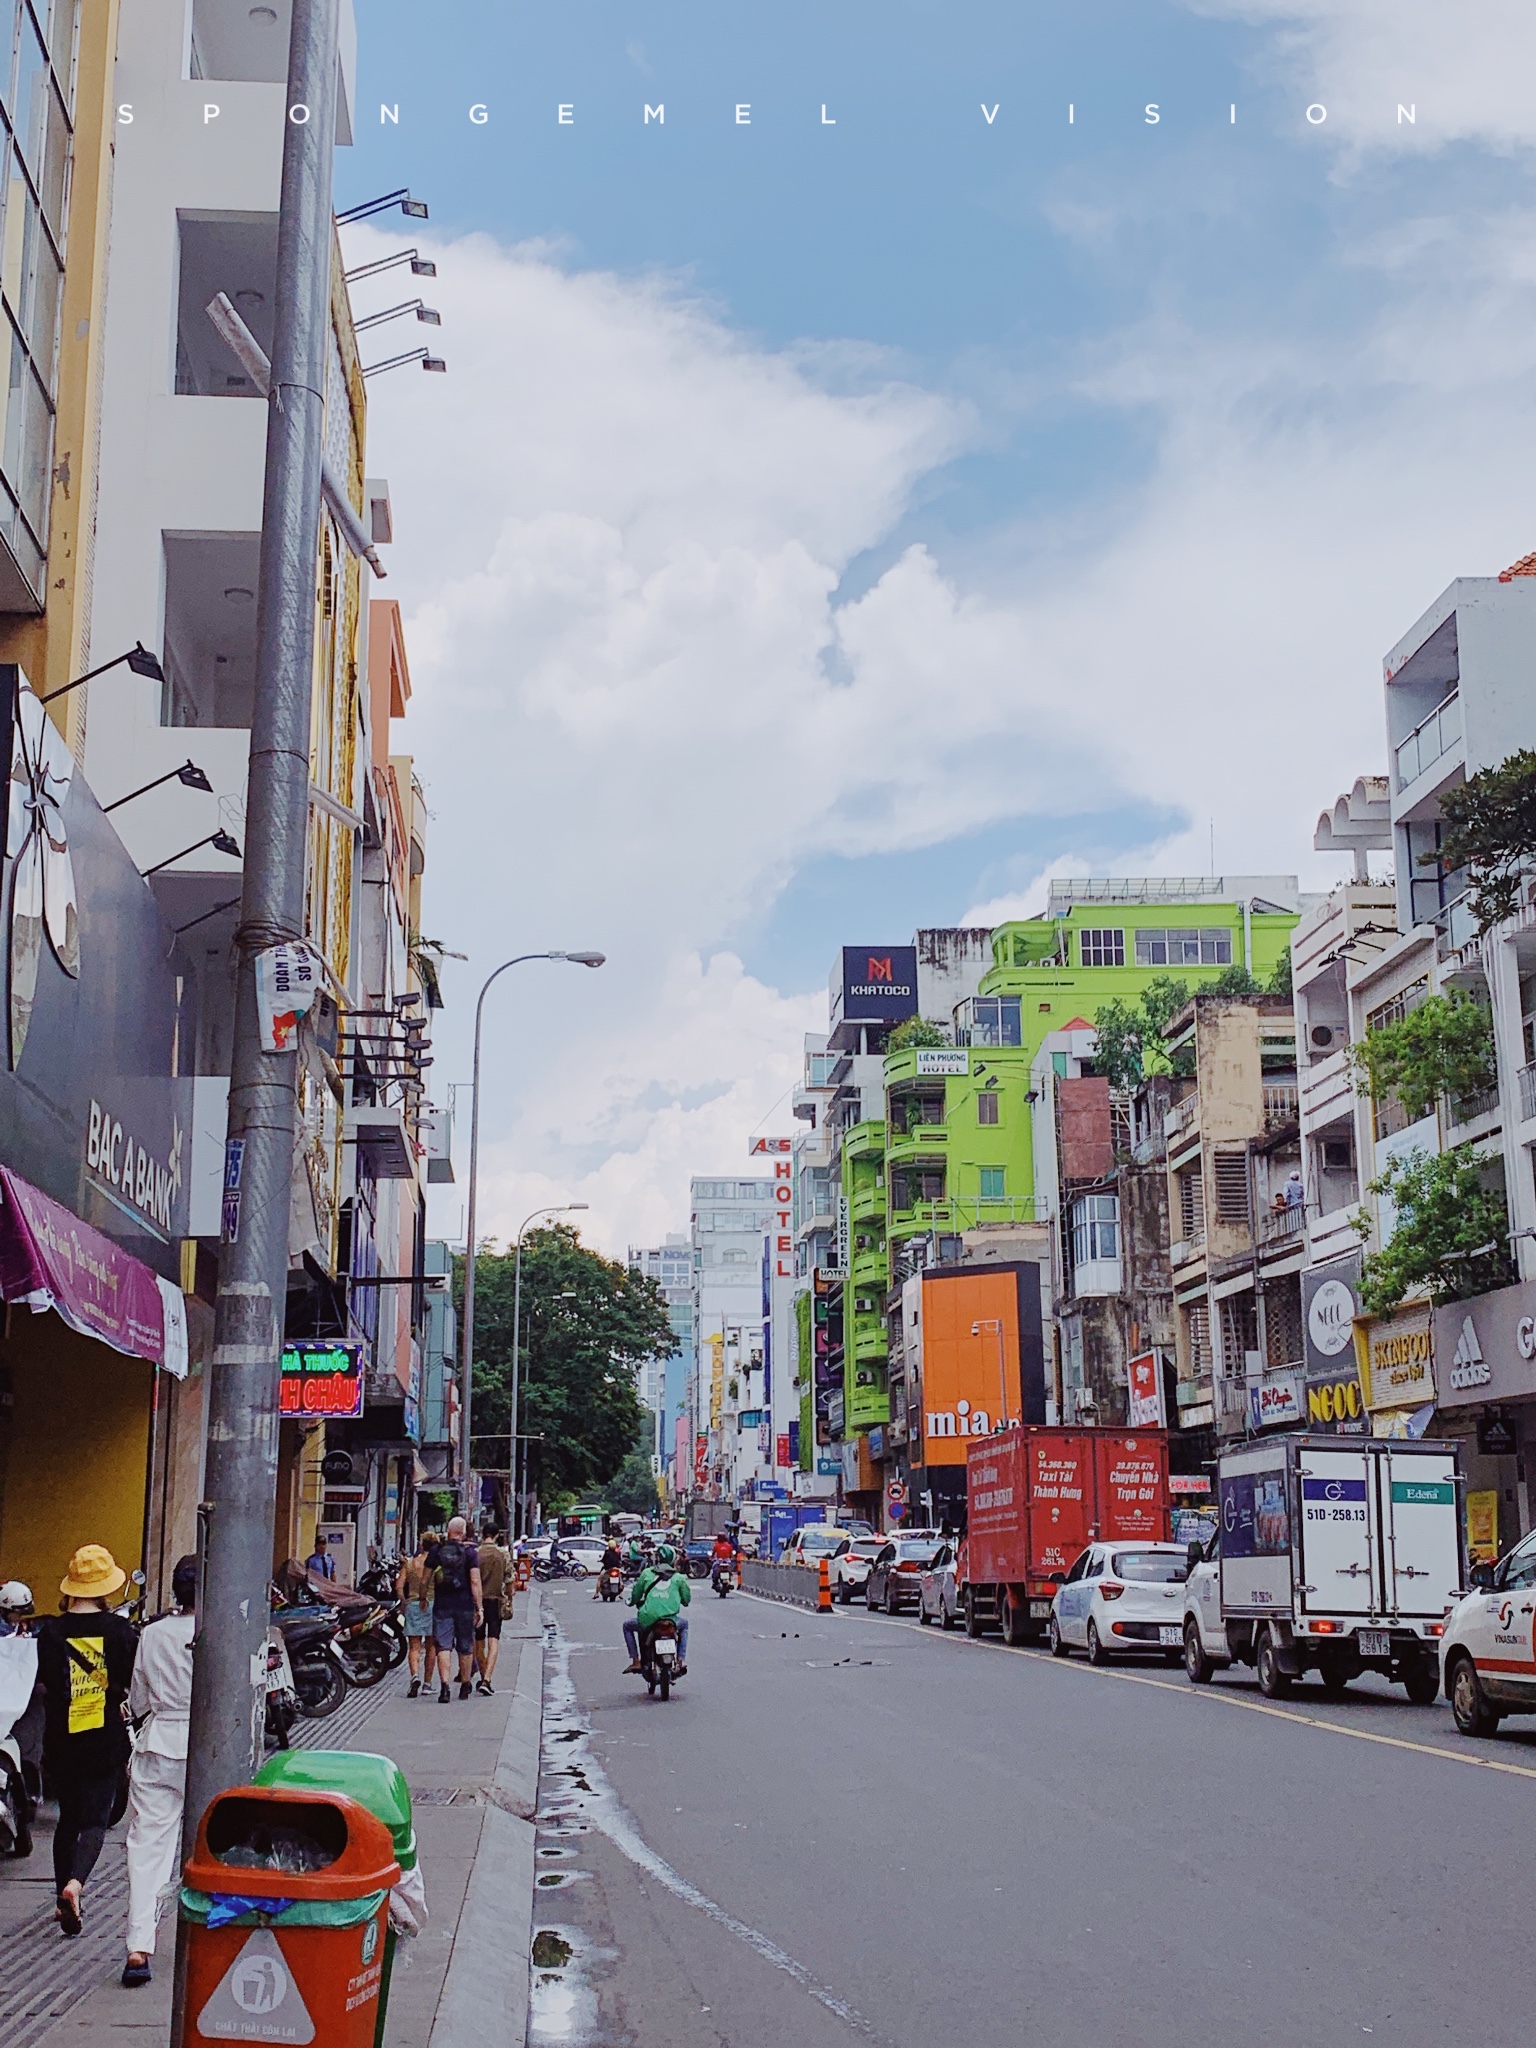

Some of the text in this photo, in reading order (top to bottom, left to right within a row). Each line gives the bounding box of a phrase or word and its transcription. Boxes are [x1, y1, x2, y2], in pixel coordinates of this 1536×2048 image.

[850, 985, 911, 996] KHATOCO
[922, 1064, 963, 1073] HOTEL
[87, 1099, 123, 1185] BAC
[121, 1135, 134, 1200] A
[135, 1145, 174, 1232] BANK
[775, 1162, 792, 1277] HOTEL
[839, 1197, 849, 1268] EVERGREEN
[820, 1269, 848, 1279] HOTEL
[1517, 1315, 1536, 1359] G
[281, 1349, 349, 1372] HÀ THUỐC
[1450, 1361, 1491, 1389] adidas
[303, 1372, 357, 1411] CHÂU
[1038, 1471, 1058, 1482] Taxi
[1033, 1485, 1059, 1499] Thành
[1138, 1487, 1155, 1500] Gói
[1406, 1488, 1438, 1500] Edena
